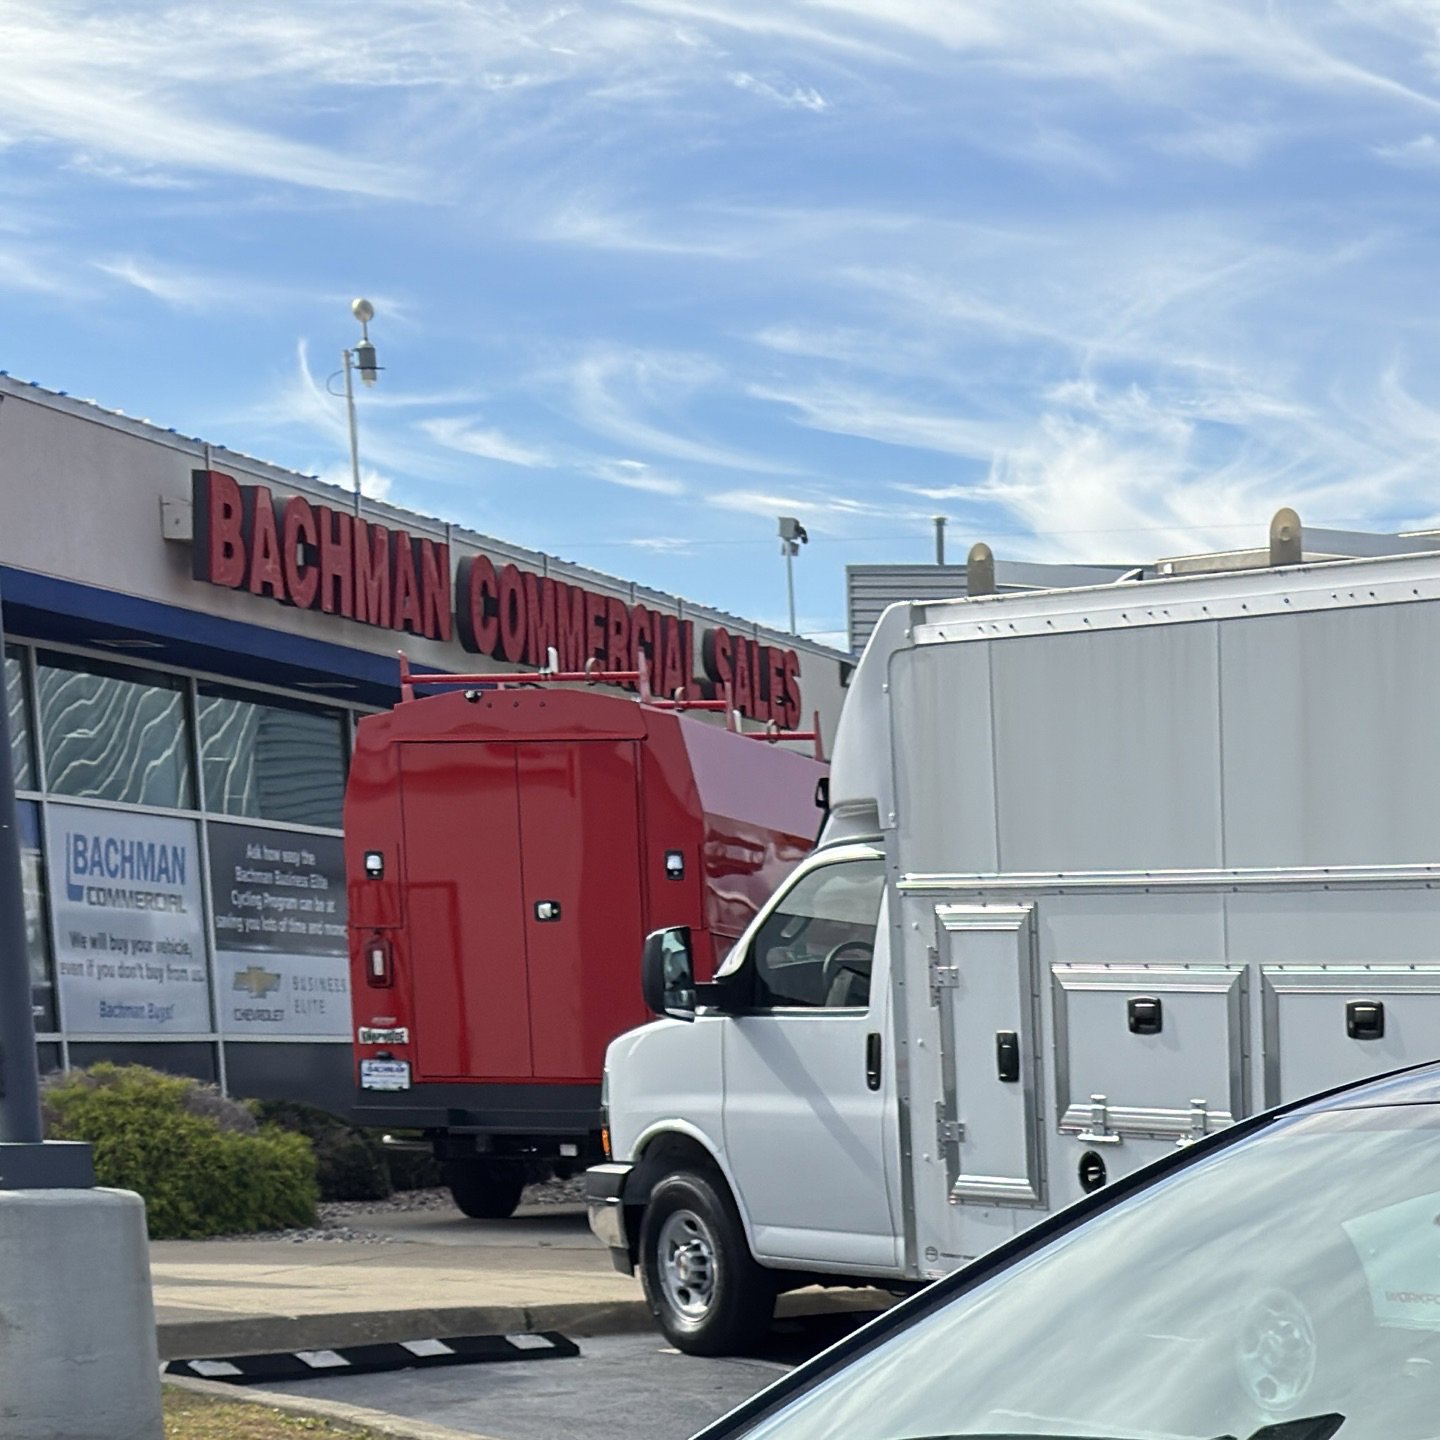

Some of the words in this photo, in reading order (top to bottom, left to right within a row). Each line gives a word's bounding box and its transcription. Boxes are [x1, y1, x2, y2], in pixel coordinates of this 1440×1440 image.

[205, 469, 452, 641] BACHMAN
[468, 553, 700, 700] COMMERCIAL
[712, 625, 801, 730] SALES
[73, 833, 186, 886] BACHMAN
[86, 886, 188, 914] COMMERCIAL
[68, 931, 87, 949] We
[89, 932, 108, 950] will
[109, 934, 129, 955] buy
[131, 939, 153, 956] your
[96, 964, 115, 981] you
[145, 963, 164, 984] buy
